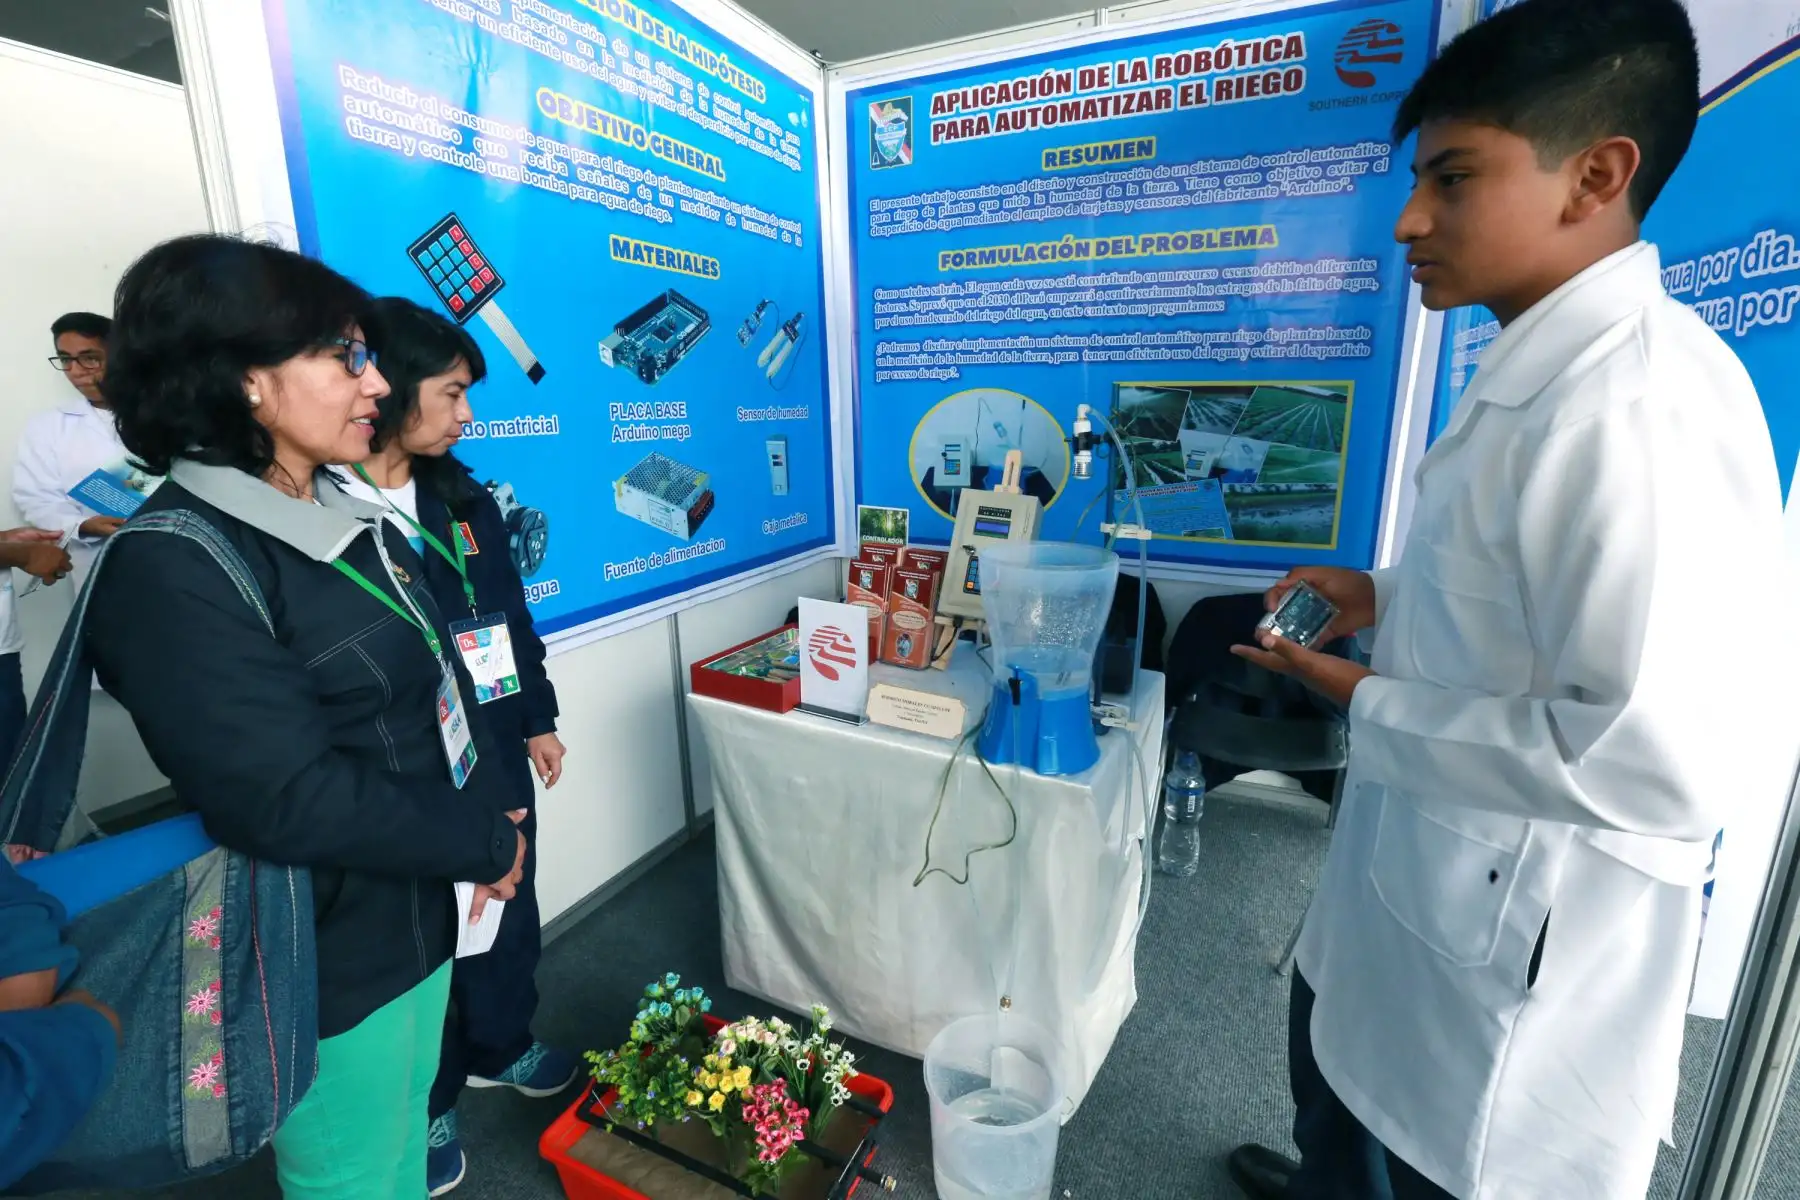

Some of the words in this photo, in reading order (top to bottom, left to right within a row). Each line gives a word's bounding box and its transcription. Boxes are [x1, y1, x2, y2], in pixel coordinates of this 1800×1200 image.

[641, 15, 666, 45] DE
[667, 30, 691, 59] LA
[691, 45, 766, 103] HIPÓTESIS
[931, 69, 1073, 116] APLICACIÓN
[1078, 64, 1111, 92] DE
[1115, 59, 1149, 86] LA
[1153, 32, 1306, 80] ROBÓTICA
[931, 114, 991, 144] PARA
[993, 85, 1173, 135] AUTOMATIZAR
[1177, 81, 1208, 108] EL
[1213, 65, 1306, 105] RIEGO
[1308, 95, 1369, 112] SOUTHERN
[536, 87, 649, 150] OBJETIVO
[650, 131, 726, 181] GENERAL
[1043, 137, 1155, 170] RESUMEN
[346, 115, 401, 149] tierra
[402, 138, 416, 157] y
[419, 143, 486, 173] controle
[488, 164, 520, 182] una
[521, 170, 569, 195] bomba
[570, 186, 597, 202] para
[600, 194, 629, 211] agua
[630, 198, 643, 214] de
[644, 203, 672, 223] riego.
[870, 199, 880, 210] El
[881, 195, 920, 212] presente
[921, 190, 955, 204] trabajo
[957, 185, 999, 200] consiste
[1001, 185, 1015, 195] en
[1017, 181, 1027, 193] el
[1030, 178, 1065, 191] diseño
[1067, 178, 1075, 190] y
[1077, 168, 1150, 186] construcción
[1154, 166, 1169, 178] de
[1172, 166, 1188, 176] un
[1190, 160, 1239, 174] sistema
[1242, 156, 1258, 169] de
[1261, 149, 1310, 167] control
[1311, 143, 1390, 162] automático
[871, 213, 890, 225] para
[894, 209, 918, 221] riego
[922, 207, 934, 217] de
[939, 203, 974, 217] plantas
[979, 201, 999, 213] que
[1003, 196, 1030, 208] mide
[1034, 194, 1044, 205] la
[1051, 187, 1101, 203] humedad
[1106, 186, 1122, 197] de
[1126, 184, 1138, 195] la
[1143, 182, 1179, 193] tierra.
[1185, 177, 1218, 189] Tiene
[1224, 174, 1261, 185] como
[1267, 166, 1321, 182] objetivo
[1327, 162, 1367, 175] evitar
[1373, 158, 1388, 171] el
[871, 220, 922, 236] desperdicio
[924, 219, 937, 229] de
[938, 218, 962, 230] agua
[964, 211, 1009, 225] mediante
[1011, 209, 1022, 220] el
[1023, 206, 1062, 220] empleo
[1065, 204, 1079, 215] de
[1081, 200, 1123, 215] tarjetas
[1124, 201, 1134, 212] y
[1135, 196, 1188, 208] sensores
[1192, 191, 1213, 203] del
[1214, 185, 1279, 202] fabricante
[611, 235, 719, 278] MATERIALES
[939, 237, 1091, 270] FORMULACIÓN
[1095, 239, 1136, 256] DEL
[1140, 225, 1277, 254] PROBLEMA
[1695, 248, 1738, 296] por
[1736, 286, 1800, 335] por
[491, 415, 558, 437] matricial
[610, 403, 653, 421] PLACA
[655, 402, 686, 419] BASE
[611, 425, 659, 443] Arduino
[662, 424, 691, 441] mega
[737, 406, 765, 422] Sensor
[766, 406, 777, 420] de
[778, 405, 808, 419] humedad
[762, 520, 779, 535] Caja
[863, 534, 903, 544] CONTROLADOR
[604, 560, 646, 581] Fuente
[648, 553, 663, 569] de
[663, 537, 725, 567] alimentacion
